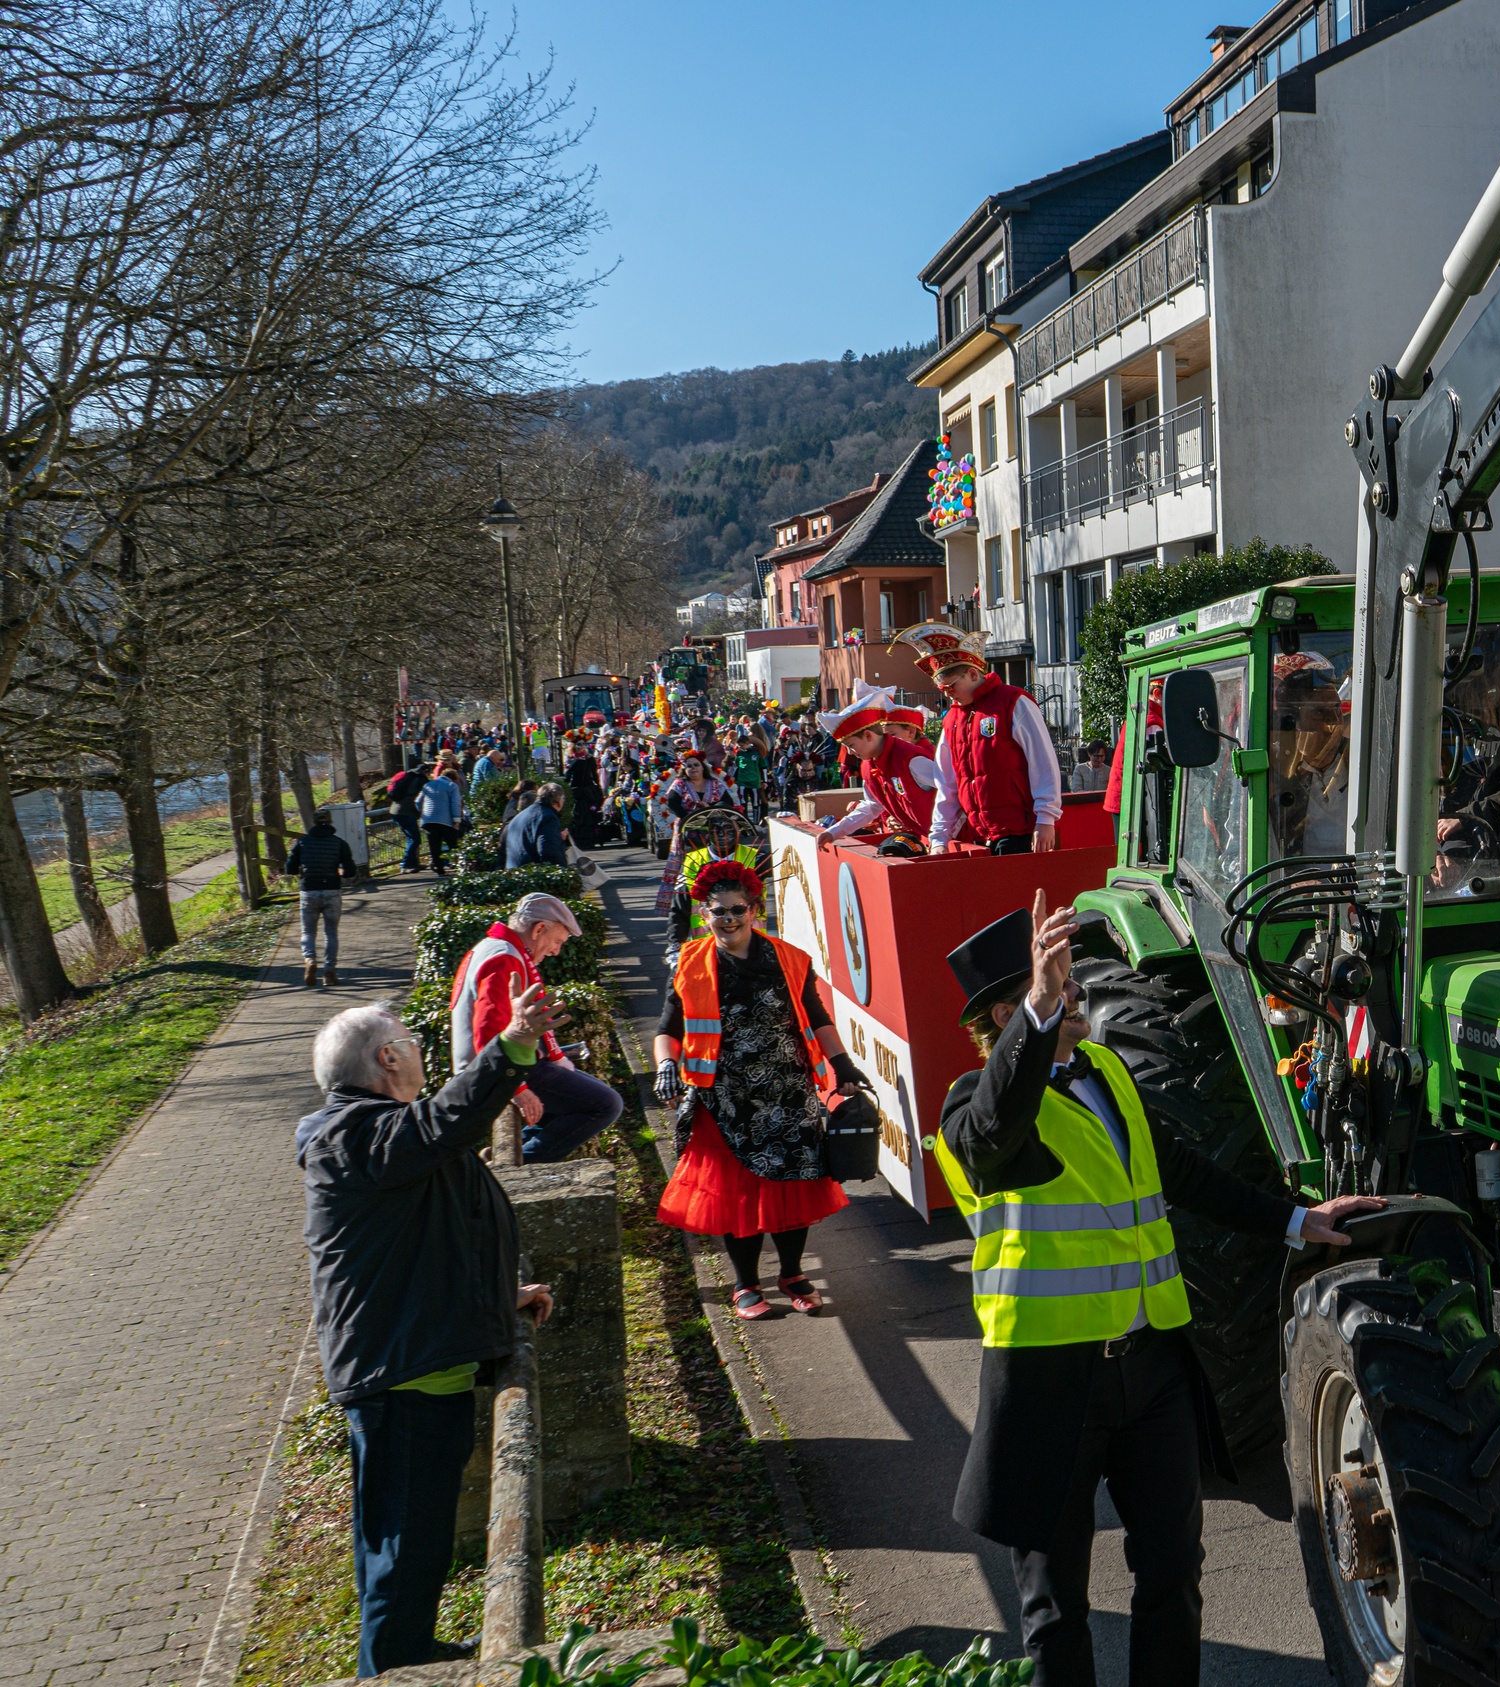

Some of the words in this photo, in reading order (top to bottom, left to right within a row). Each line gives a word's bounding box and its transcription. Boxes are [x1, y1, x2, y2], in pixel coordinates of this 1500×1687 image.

[1148, 623, 1177, 645] DEUTZ
[850, 1017, 866, 1061] KG
[873, 1037, 899, 1091] UHU
[878, 1108, 912, 1172] DORF
